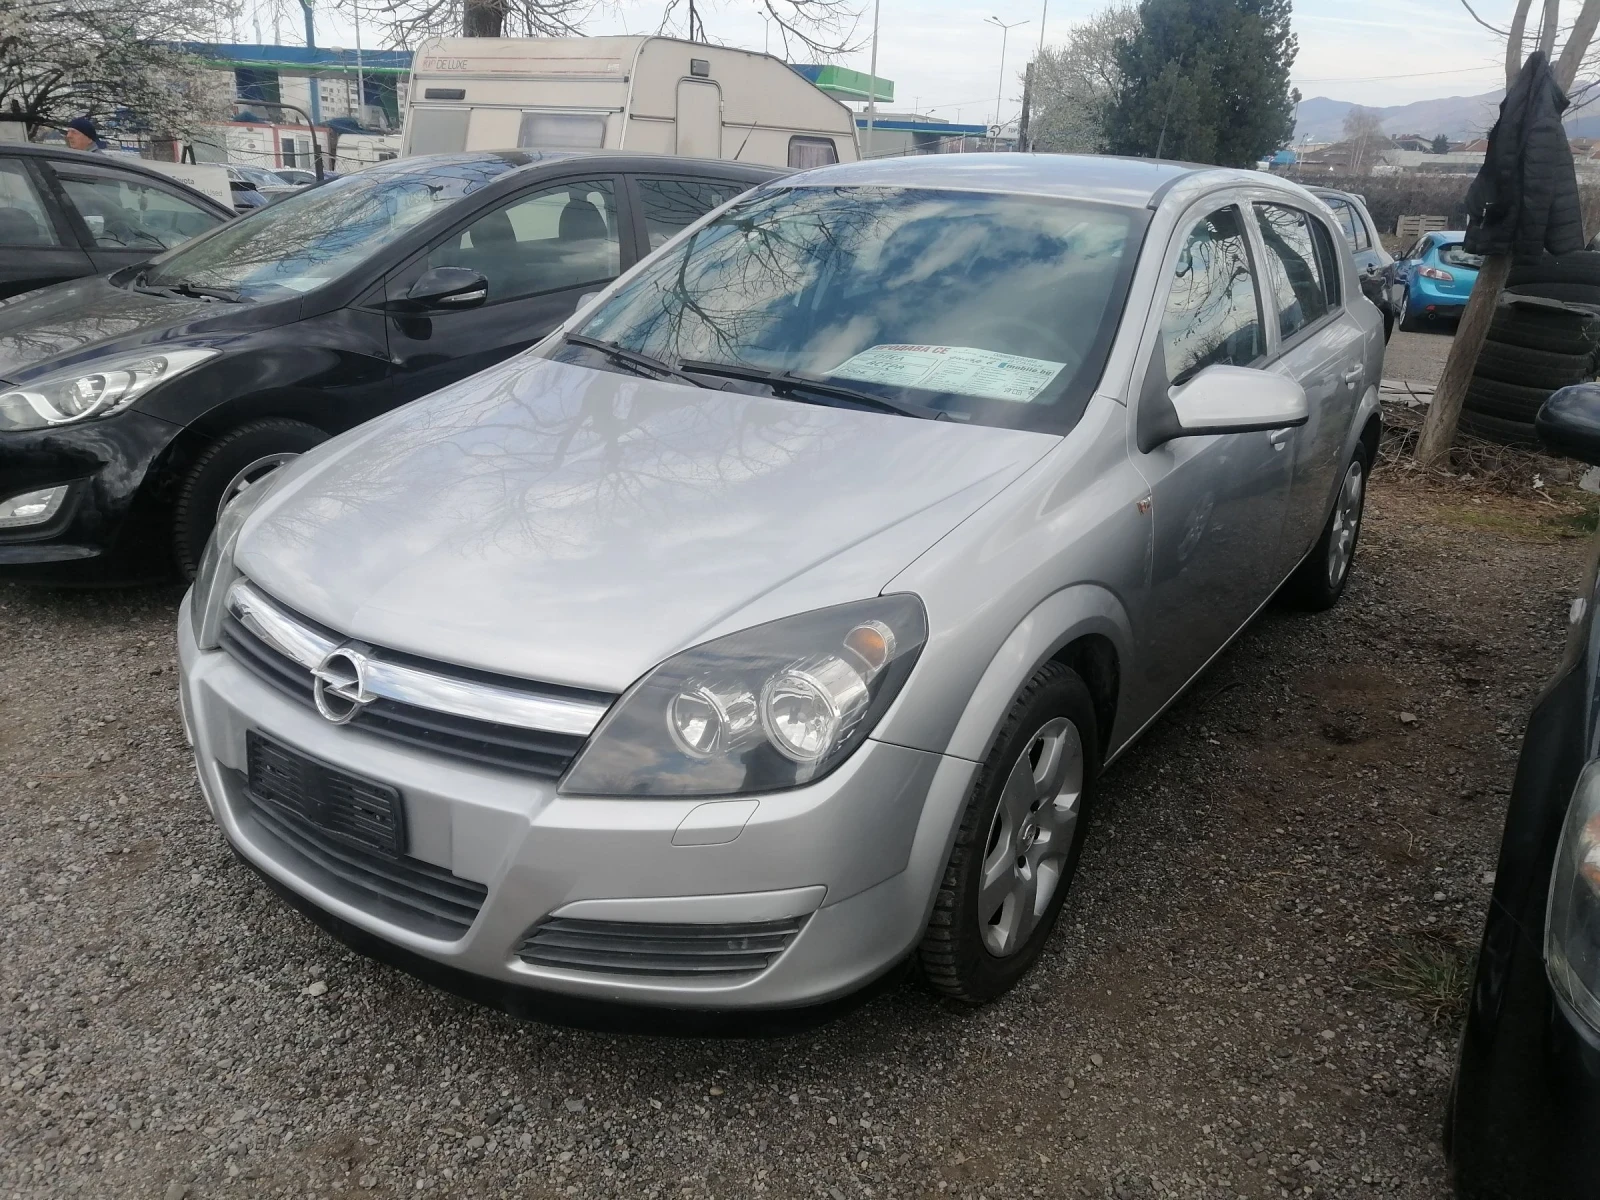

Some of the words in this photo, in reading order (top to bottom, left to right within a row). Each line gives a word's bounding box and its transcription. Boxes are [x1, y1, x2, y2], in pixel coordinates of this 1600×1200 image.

[436, 60, 447, 69] DE
[448, 60, 468, 70] LUXE
[207, 189, 223, 197] Used
[932, 347, 951, 355] СЕ
